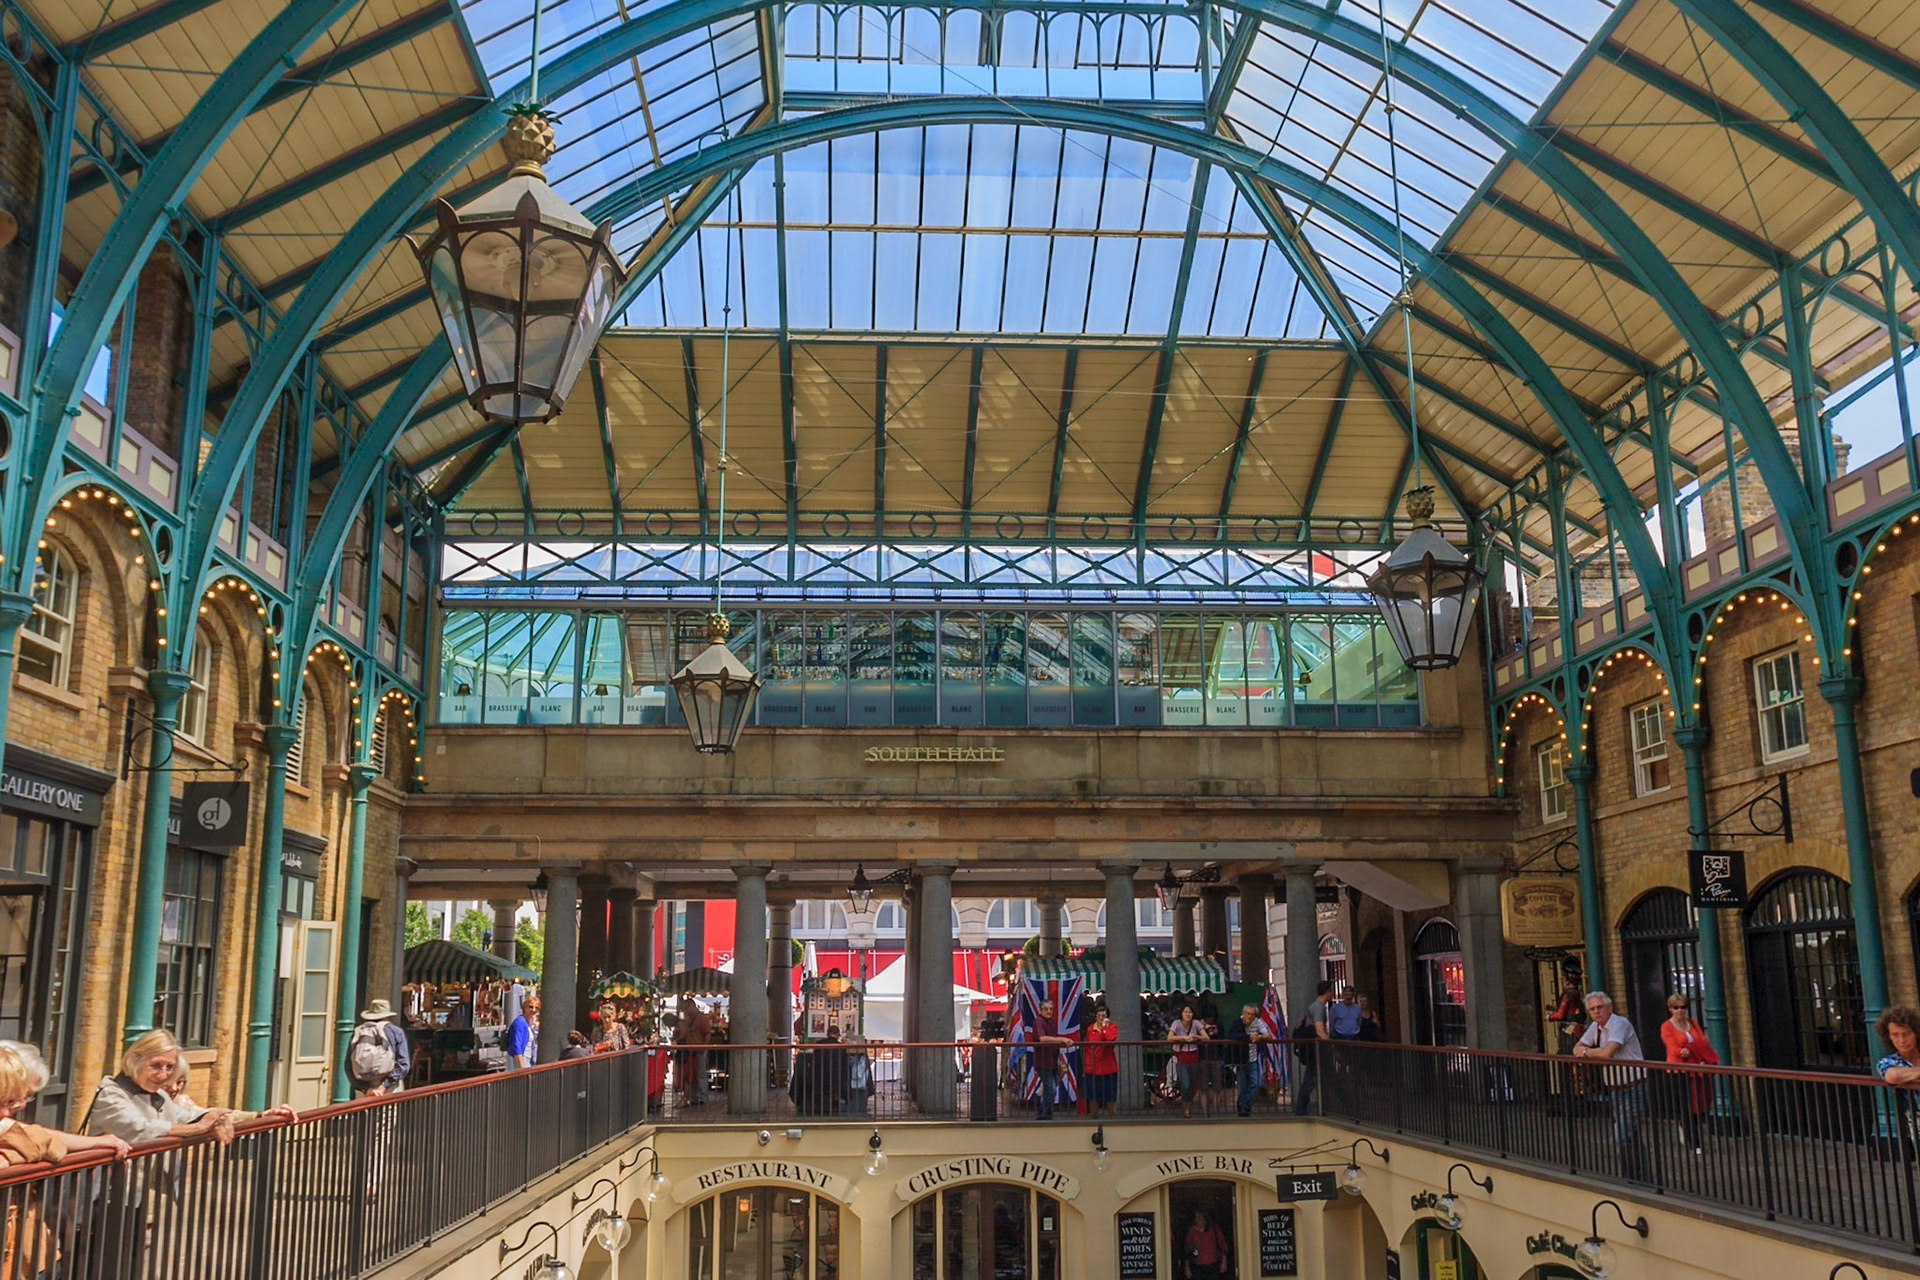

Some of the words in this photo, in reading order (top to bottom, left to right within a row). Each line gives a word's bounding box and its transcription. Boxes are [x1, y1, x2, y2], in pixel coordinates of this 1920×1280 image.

[454, 705, 467, 713] BAR
[488, 705, 524, 713] BRASSERIE
[540, 705, 562, 713] BLANC
[592, 705, 605, 713] BAR
[763, 705, 798, 713] BRASSERIE
[815, 705, 837, 713] BLANC
[864, 705, 877, 713] BAR
[951, 705, 972, 713] BLANC
[1133, 705, 1146, 713] BAR
[1166, 706, 1200, 714] BRASSERIE
[1216, 706, 1236, 714] BLANC
[1263, 706, 1276, 714] BAR
[866, 746, 941, 762] SOUTH
[946, 746, 1002, 762] HALL
[0, 773, 56, 804] GALLERY
[56, 789, 84, 811] ONE
[1705, 883, 1731, 897] Pain
[1156, 1155, 1205, 1176] WINE
[1215, 1155, 1253, 1175] BAR
[697, 1162, 832, 1190] RESTAURANT
[908, 1157, 1011, 1193] CRUSTING
[1020, 1161, 1069, 1194] PIPE
[1292, 1179, 1322, 1195] Exit
[1121, 1226, 1152, 1235] WINES
[1262, 1229, 1293, 1237] STEAKS
[1130, 1236, 1151, 1244] RARE
[1526, 1229, 1551, 1255] Café
[1123, 1244, 1152, 1253] PORTS
[1121, 1260, 1154, 1268] VINTAGES
